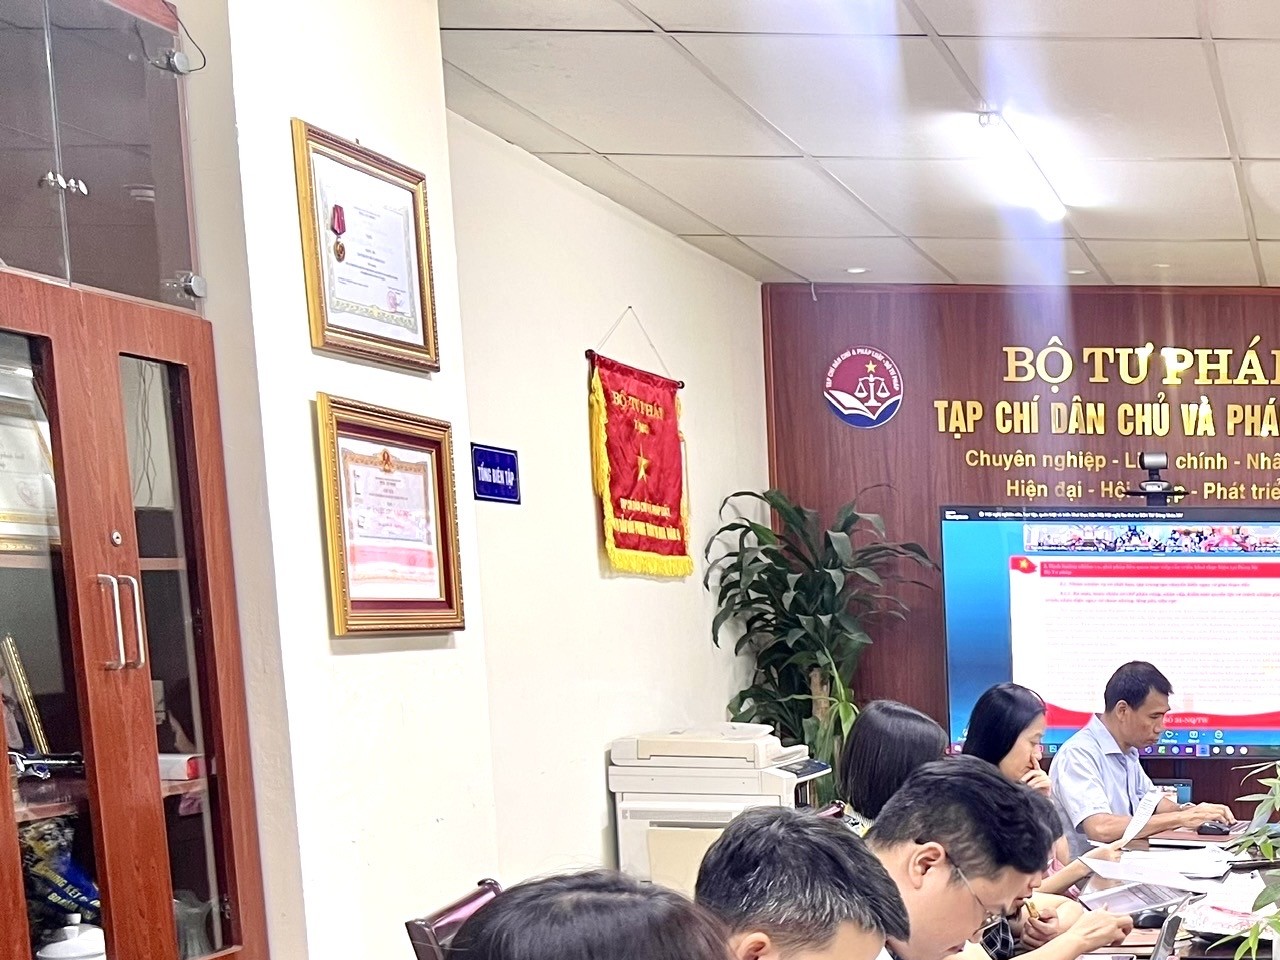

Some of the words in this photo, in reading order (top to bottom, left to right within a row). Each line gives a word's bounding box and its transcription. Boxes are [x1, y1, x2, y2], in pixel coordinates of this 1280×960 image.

[1002, 335, 1073, 393] BỘ
[1082, 342, 1155, 385] TƯ
[933, 400, 984, 439] TẠP
[995, 394, 1040, 434] CHÍ
[1050, 394, 1105, 435] DÂN
[1117, 390, 1170, 436] CHỦ
[1180, 395, 1216, 437] VÀ
[965, 449, 1036, 471] Chuyên
[1042, 451, 1107, 472] nghiệp
[1175, 452, 1228, 470] chính
[1006, 479, 1048, 501] Hiện
[1054, 481, 1082, 501] đại
[1203, 481, 1246, 500] Phát
